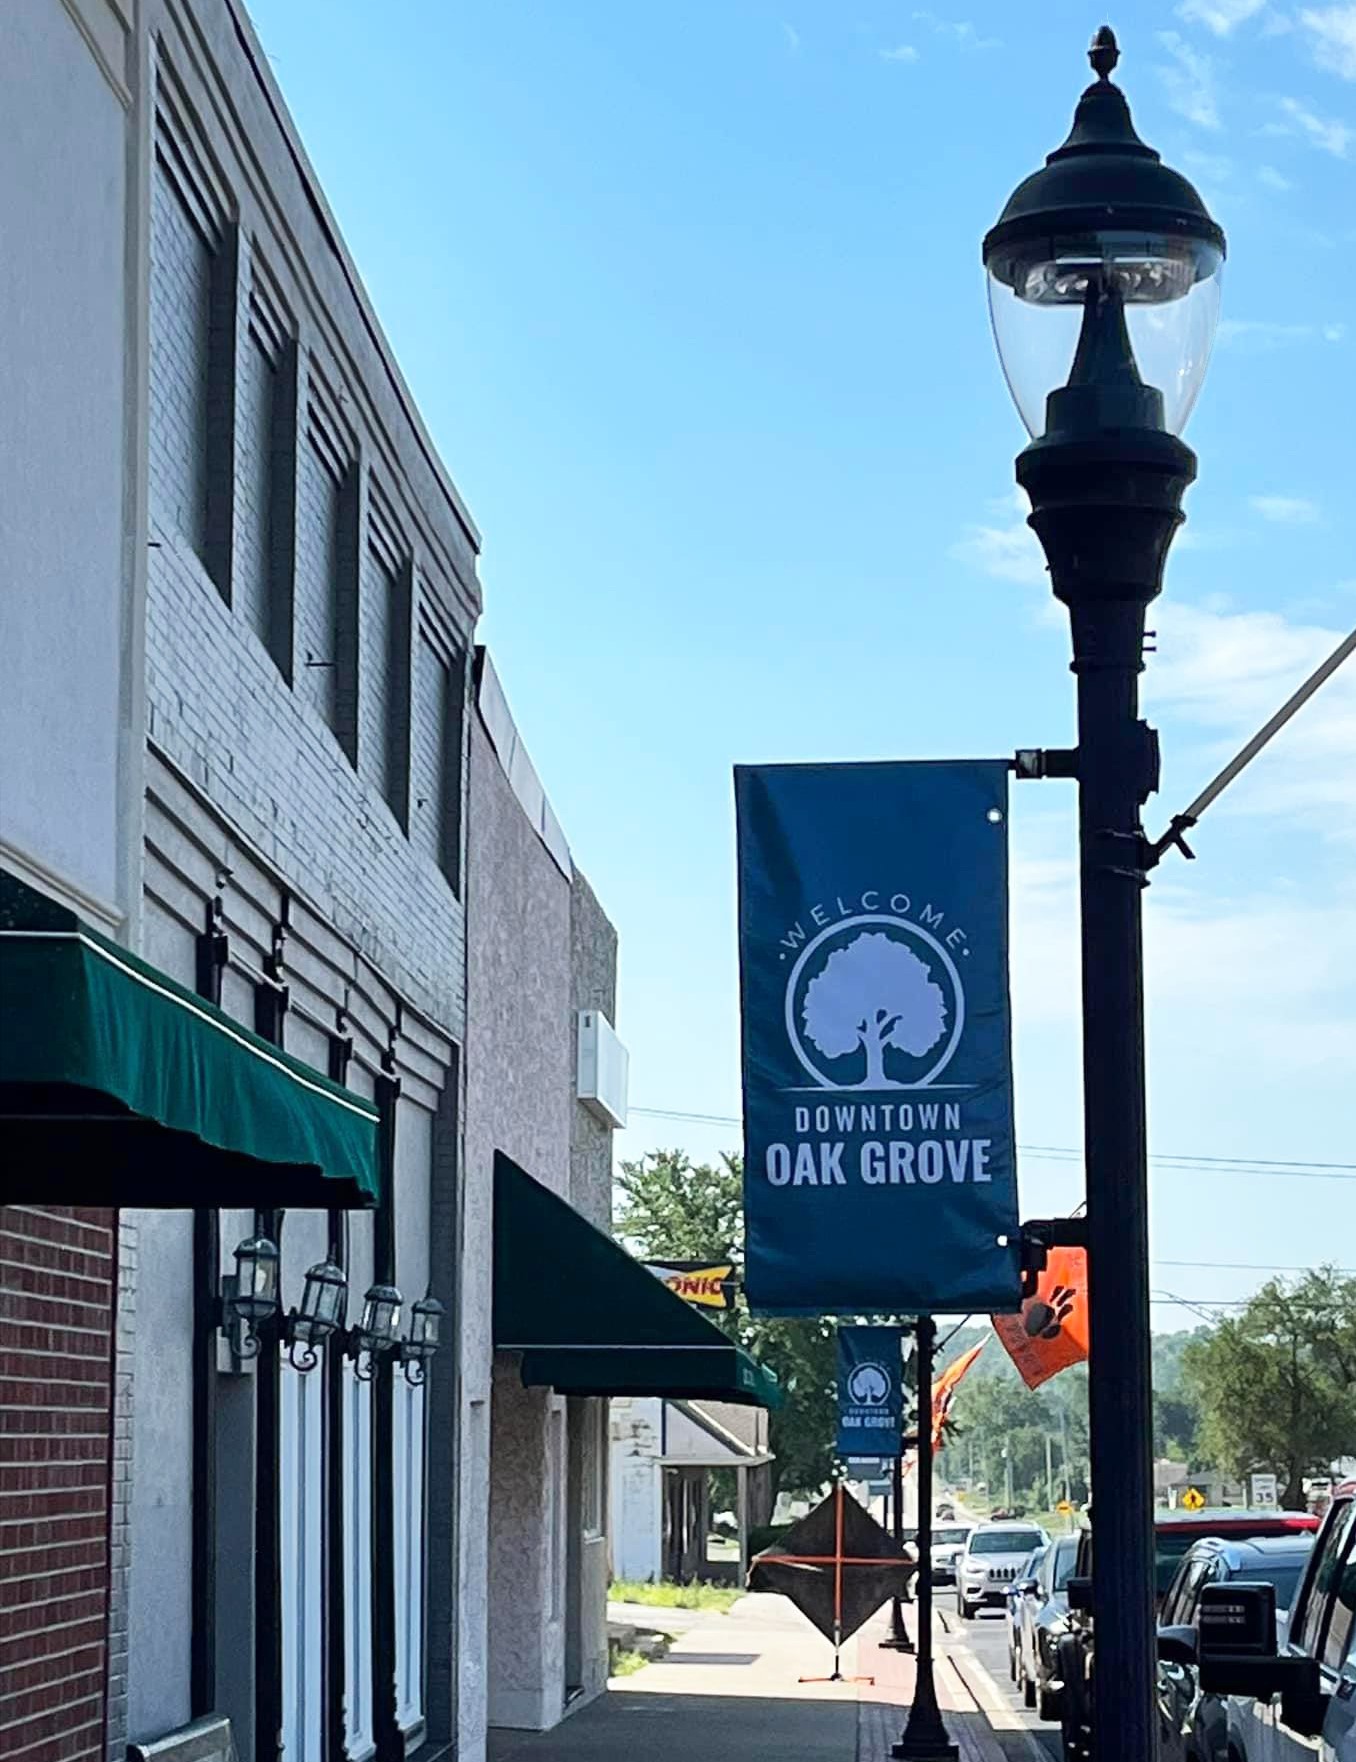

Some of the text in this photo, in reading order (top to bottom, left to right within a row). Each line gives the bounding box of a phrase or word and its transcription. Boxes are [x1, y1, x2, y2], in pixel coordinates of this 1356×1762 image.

[781, 891, 967, 949] WELCOME
[795, 1103, 961, 1133] DOWNTOWN
[765, 1139, 992, 1186] OAK GROVE
[664, 1276, 722, 1295] ONIC
